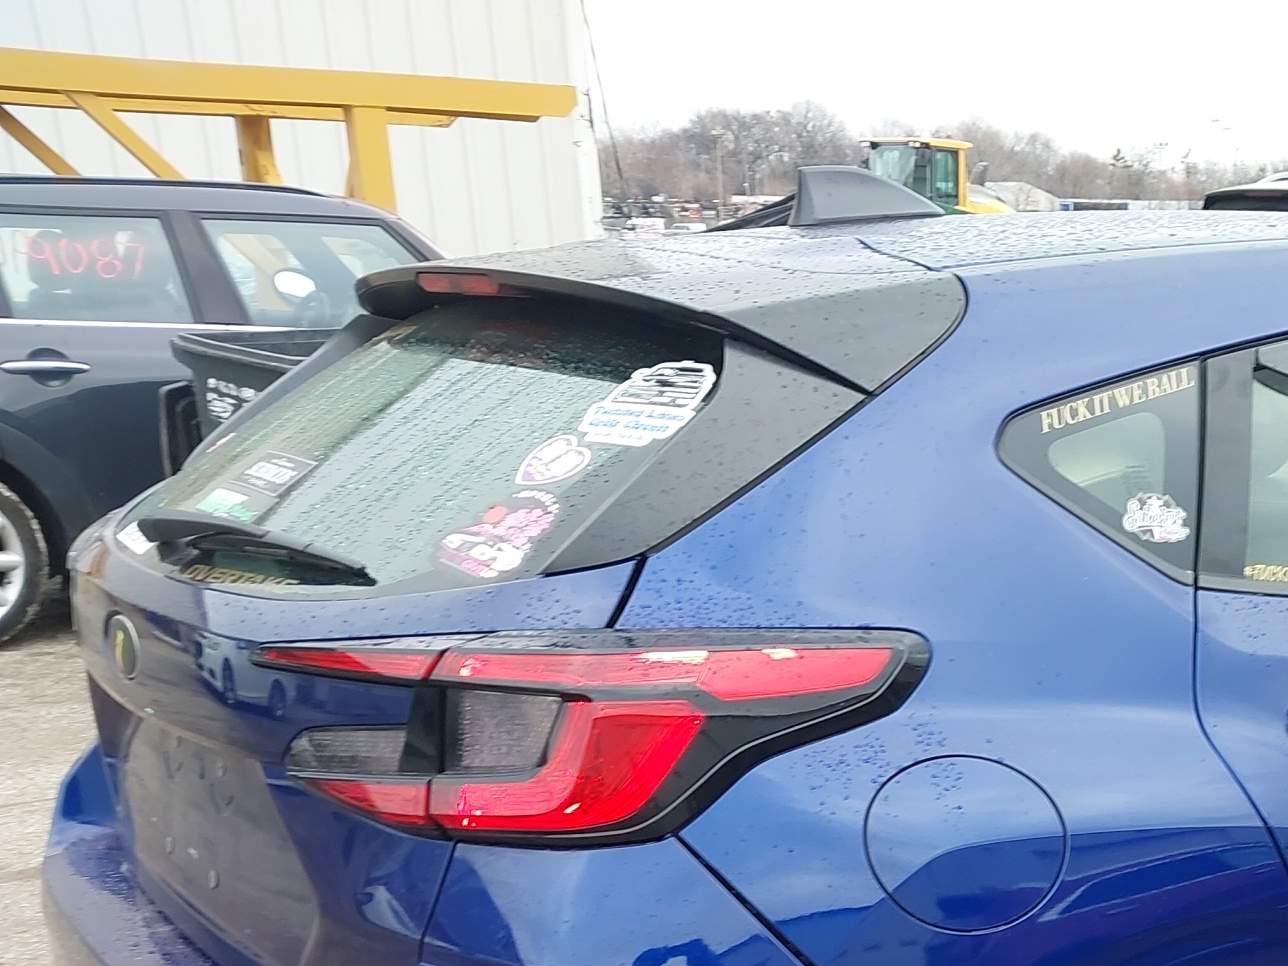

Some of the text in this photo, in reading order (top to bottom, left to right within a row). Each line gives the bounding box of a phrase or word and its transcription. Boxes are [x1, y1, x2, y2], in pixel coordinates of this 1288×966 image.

[22, 234, 145, 279] 9087
[1039, 366, 1196, 434] FUCK IT WE BALL
